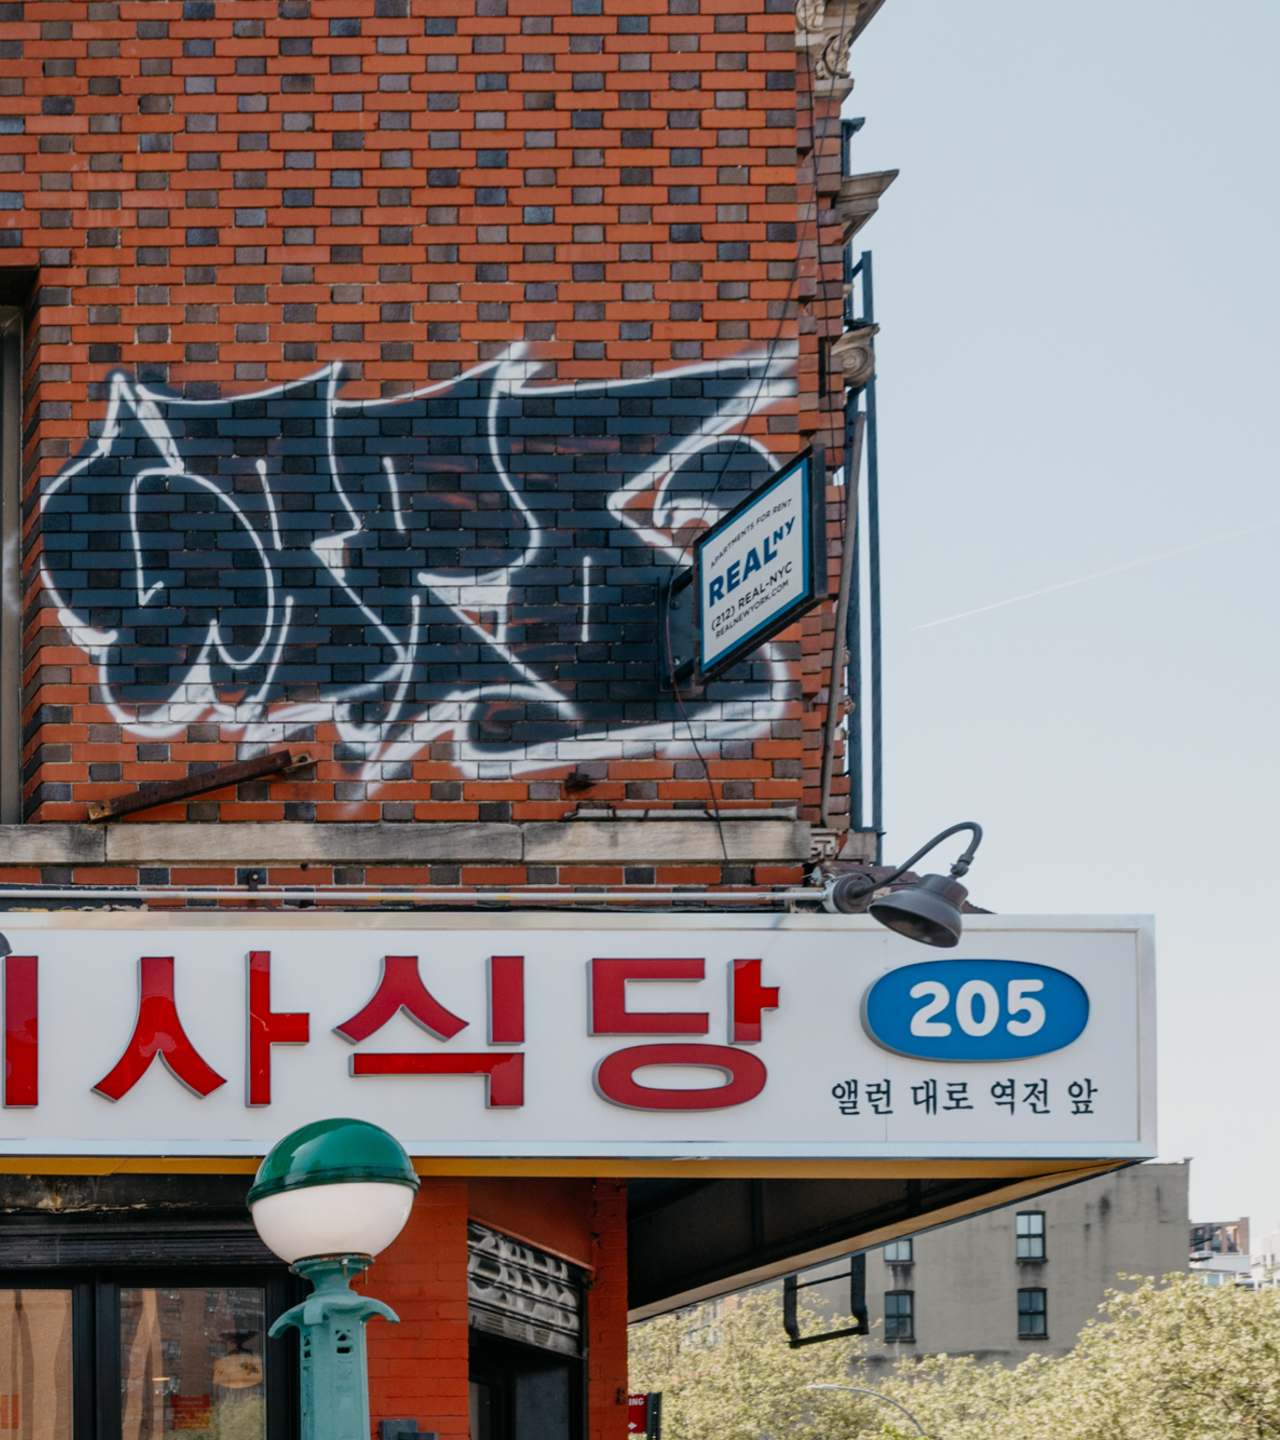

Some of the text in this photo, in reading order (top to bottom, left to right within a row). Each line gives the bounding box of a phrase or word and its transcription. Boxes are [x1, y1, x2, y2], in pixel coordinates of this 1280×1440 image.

[711, 499, 792, 567] APARTMENTS FOR RENT
[712, 561, 792, 631] (212) REAL-NYC
[715, 580, 789, 638] REALNEWYORK.COM
[909, 978, 1047, 1039] 205
[832, 1078, 1099, 1116] 앨런 대로 역전 앞
